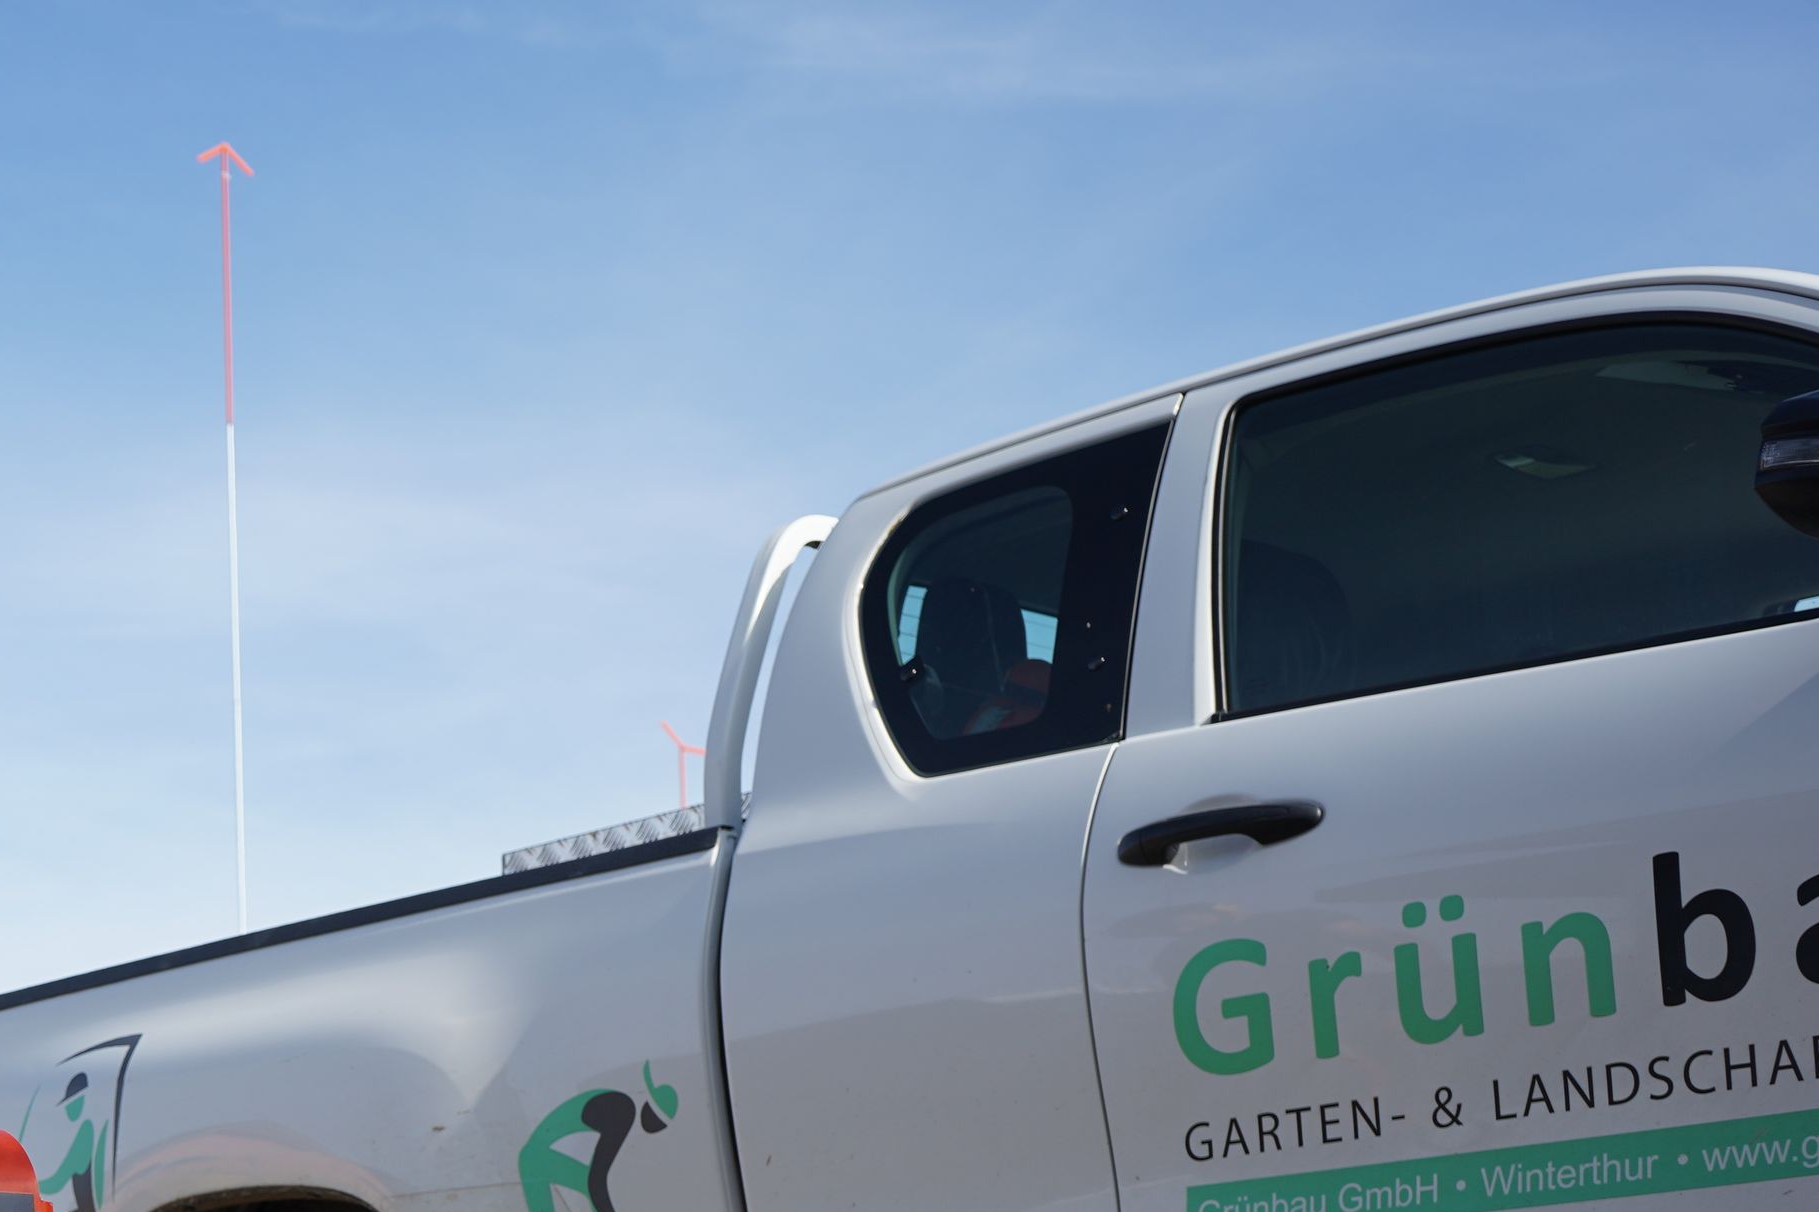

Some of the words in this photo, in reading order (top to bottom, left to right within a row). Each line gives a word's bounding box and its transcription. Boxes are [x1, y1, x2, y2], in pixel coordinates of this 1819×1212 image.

[1184, 1096, 1406, 1162] GARTEN-
[1431, 1085, 1464, 1130] &
[1480, 1154, 1660, 1199] Winterthur
